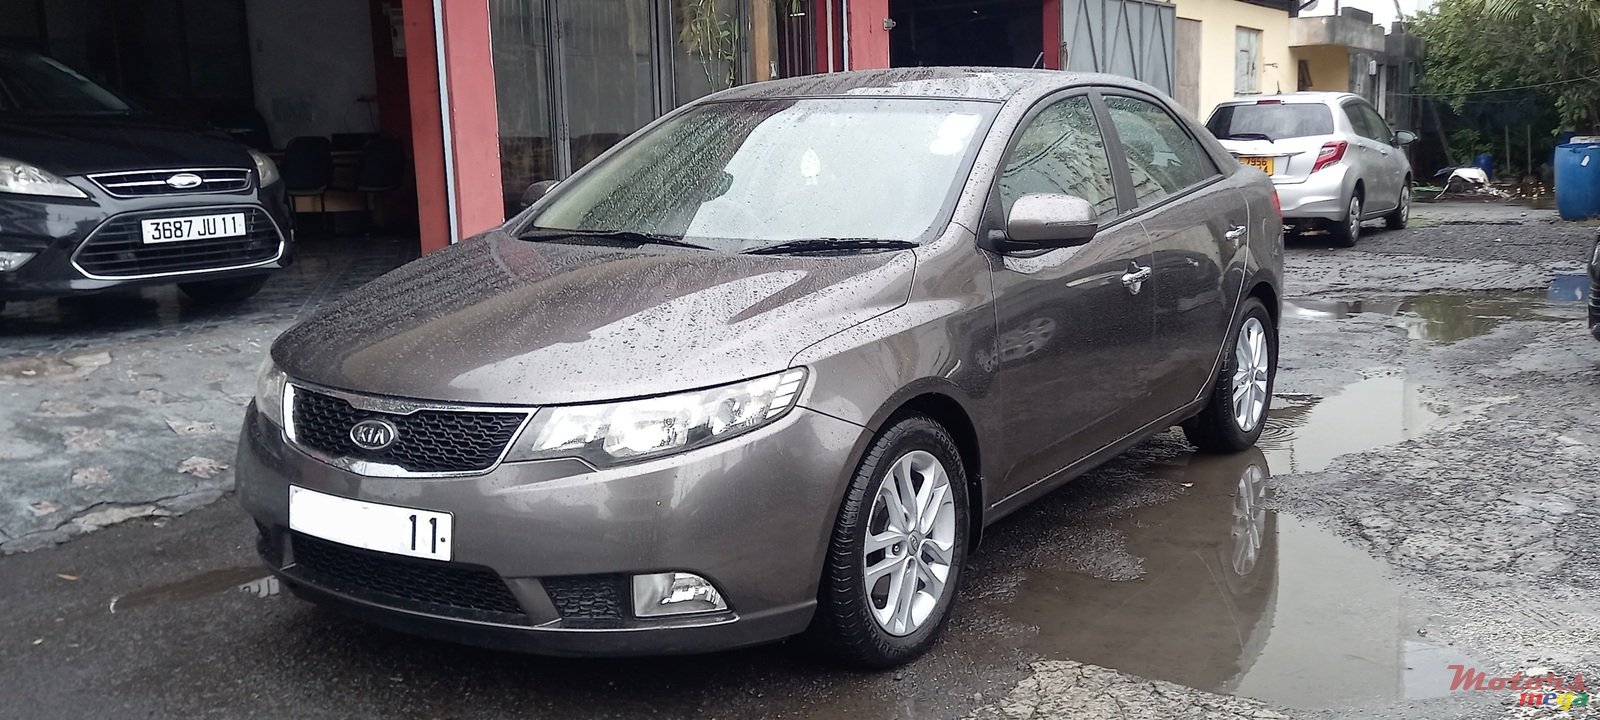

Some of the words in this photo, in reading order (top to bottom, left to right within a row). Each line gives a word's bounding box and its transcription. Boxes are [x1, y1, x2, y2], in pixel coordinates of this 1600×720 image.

[150, 219, 193, 240] 3687
[198, 218, 217, 236] JU
[222, 216, 237, 234] 11
[356, 426, 385, 445] KIA
[409, 514, 437, 554] 11
